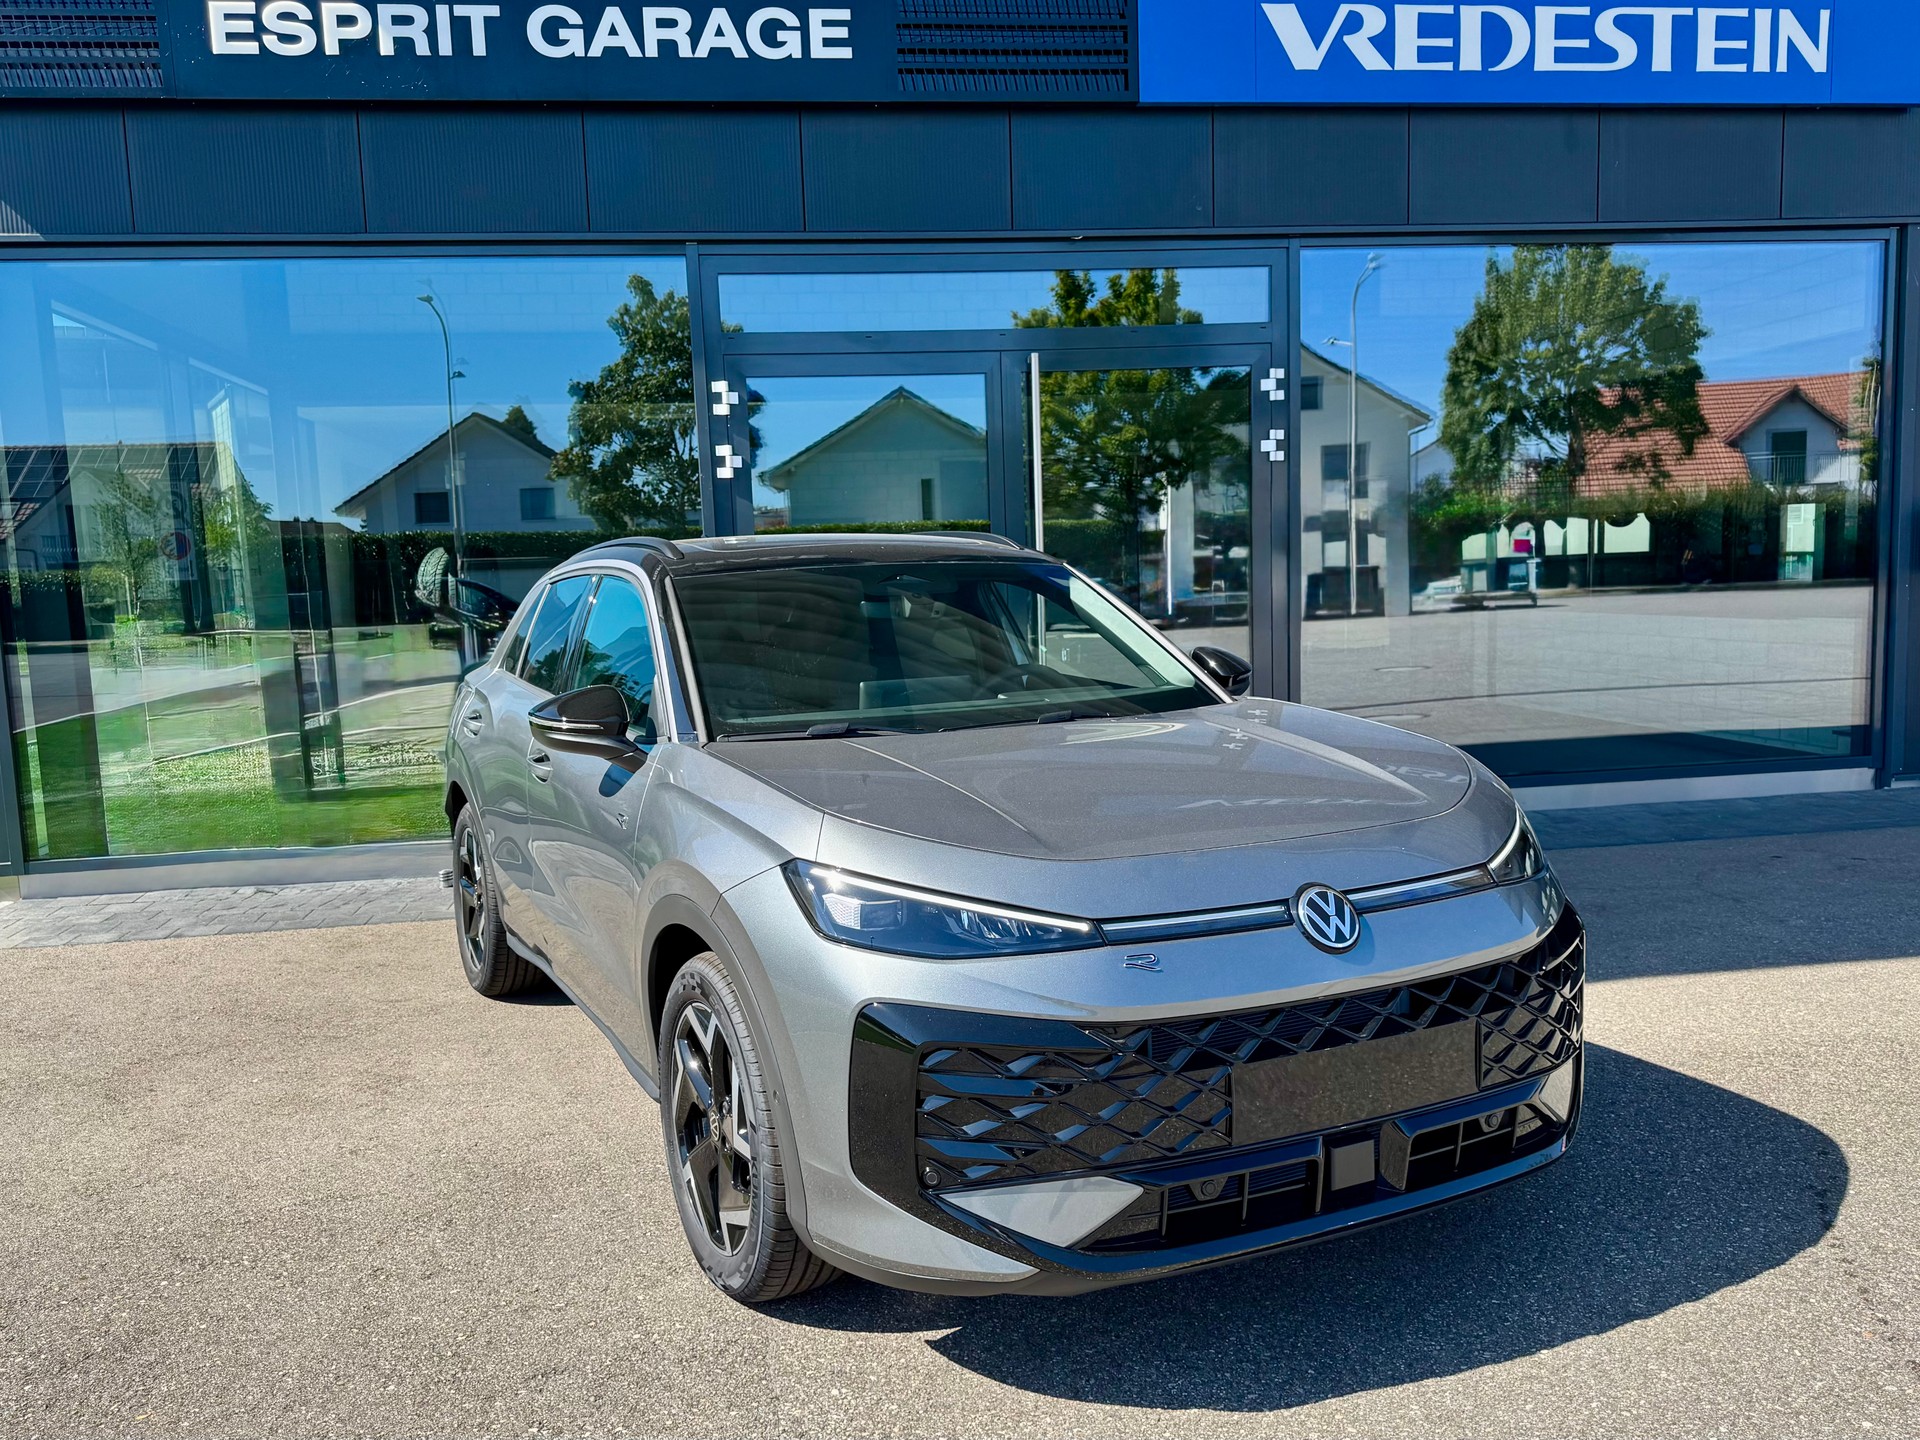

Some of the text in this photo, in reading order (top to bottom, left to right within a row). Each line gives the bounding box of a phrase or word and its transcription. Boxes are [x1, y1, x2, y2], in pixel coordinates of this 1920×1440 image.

[208, 0, 853, 60] ESPRIT GARAGE
[1260, 3, 1831, 73] VREDESTEIN
[1299, 886, 1359, 949] VW
